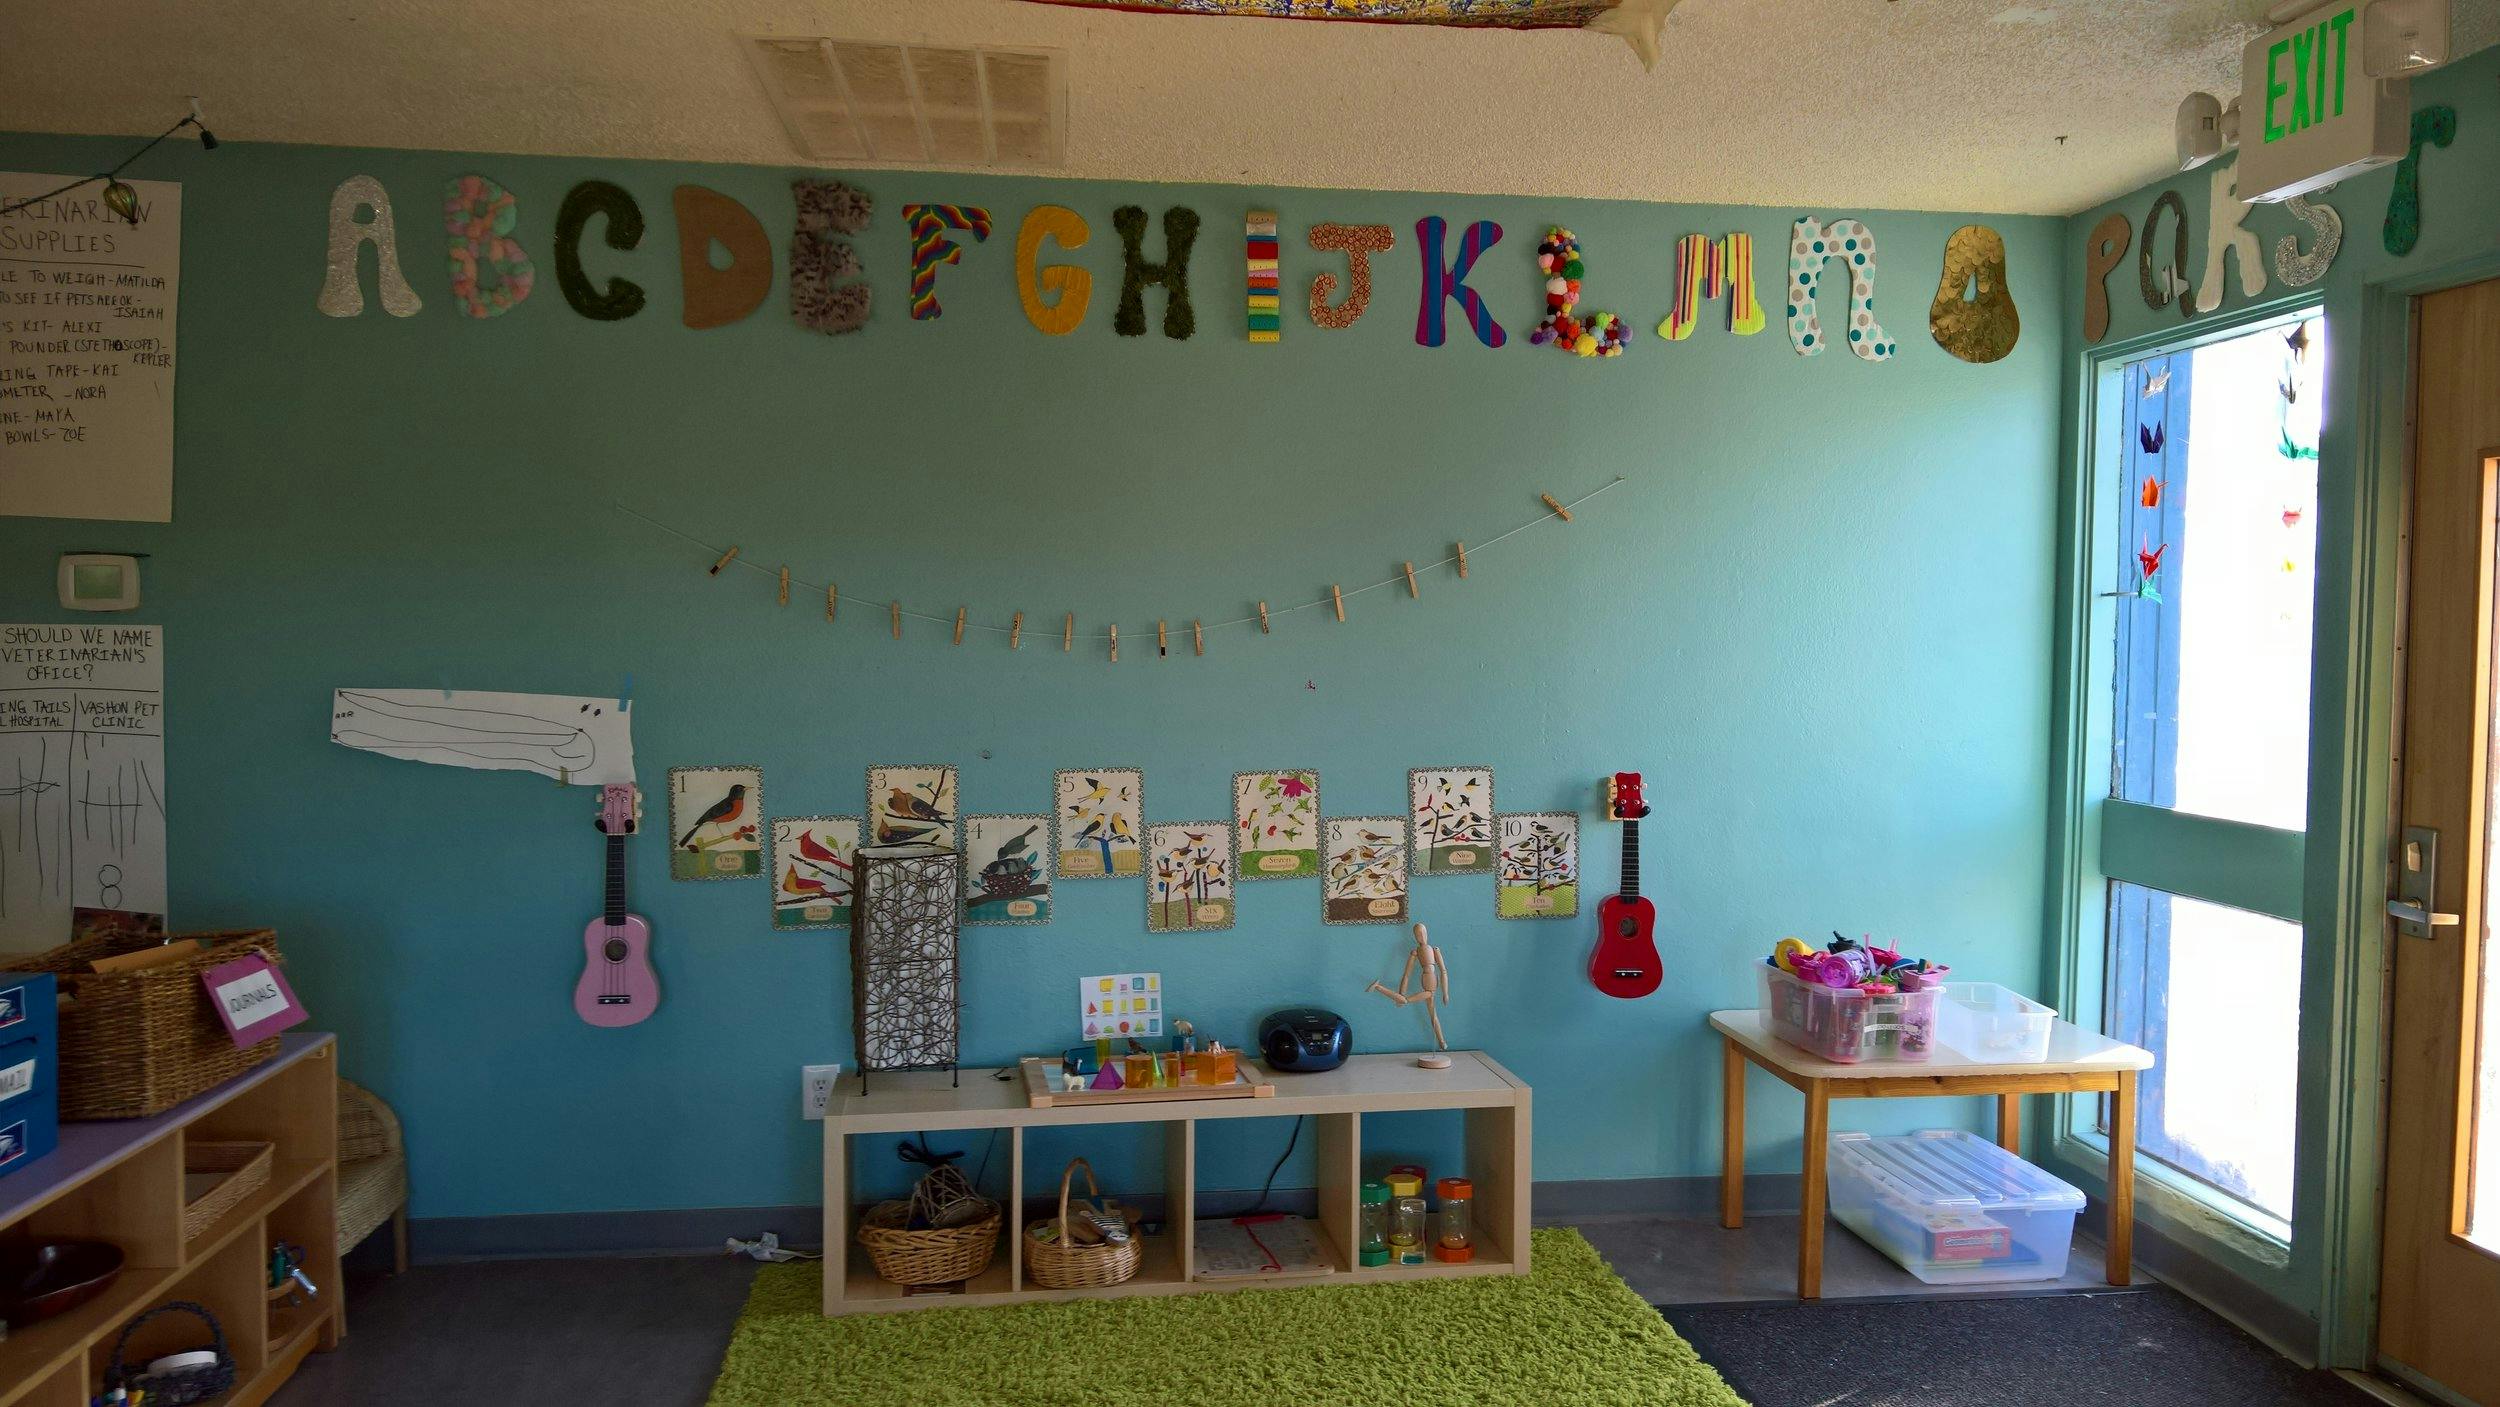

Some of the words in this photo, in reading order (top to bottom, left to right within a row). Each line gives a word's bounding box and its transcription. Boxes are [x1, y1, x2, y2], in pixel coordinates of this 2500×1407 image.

[2264, 8, 2355, 144] EXIT
[3, 196, 152, 223] ERINARIN
[0, 226, 115, 253] SUPPLIES
[2084, 213, 2131, 344] P
[2140, 190, 2195, 318] Q
[2196, 158, 2268, 313] R
[2275, 183, 2342, 287] S
[317, 175, 422, 317] A
[443, 175, 534, 318] B
[554, 180, 645, 321] C
[673, 184, 773, 330] D
[790, 178, 872, 336] E
[902, 204, 992, 321] F
[1015, 204, 1092, 336] G
[1112, 204, 1200, 340] H
[1245, 210, 1280, 343] I
[1308, 223, 1395, 329] J
[1415, 215, 1507, 348] K
[1529, 224, 1635, 357] L
[28, 269, 46, 283] TO
[15, 293, 36, 305] SEE
[44, 292, 62, 305] IF
[67, 293, 94, 306] PETS
[113, 307, 163, 320] ISAIAH
[62, 320, 102, 333] ALEXI
[10, 339, 70, 355] POUNDER
[133, 353, 172, 368] KEPLER
[36, 408, 75, 423] MAYA
[5, 627, 72, 644] SHOULD
[80, 627, 105, 644] WE
[113, 629, 152, 647] NAME
[2, 648, 146, 663] VETERINARIAN'S
[27, 664, 94, 682] OFFICE?
[33, 700, 70, 714] TAILS
[80, 700, 128, 715] VASHON
[135, 700, 159, 716] PET
[10, 715, 63, 728] HOSPITAL
[92, 716, 144, 729] CLINIC
[679, 774, 687, 794] 1
[875, 772, 887, 790] 3
[1063, 777, 1075, 793] 5
[1240, 778, 1252, 795] 7
[1418, 775, 1428, 792] 9
[779, 824, 792, 843] 2
[969, 822, 983, 840] 4
[1332, 824, 1342, 841] 8
[1504, 820, 1522, 837] 10
[1153, 829, 1166, 847] 6
